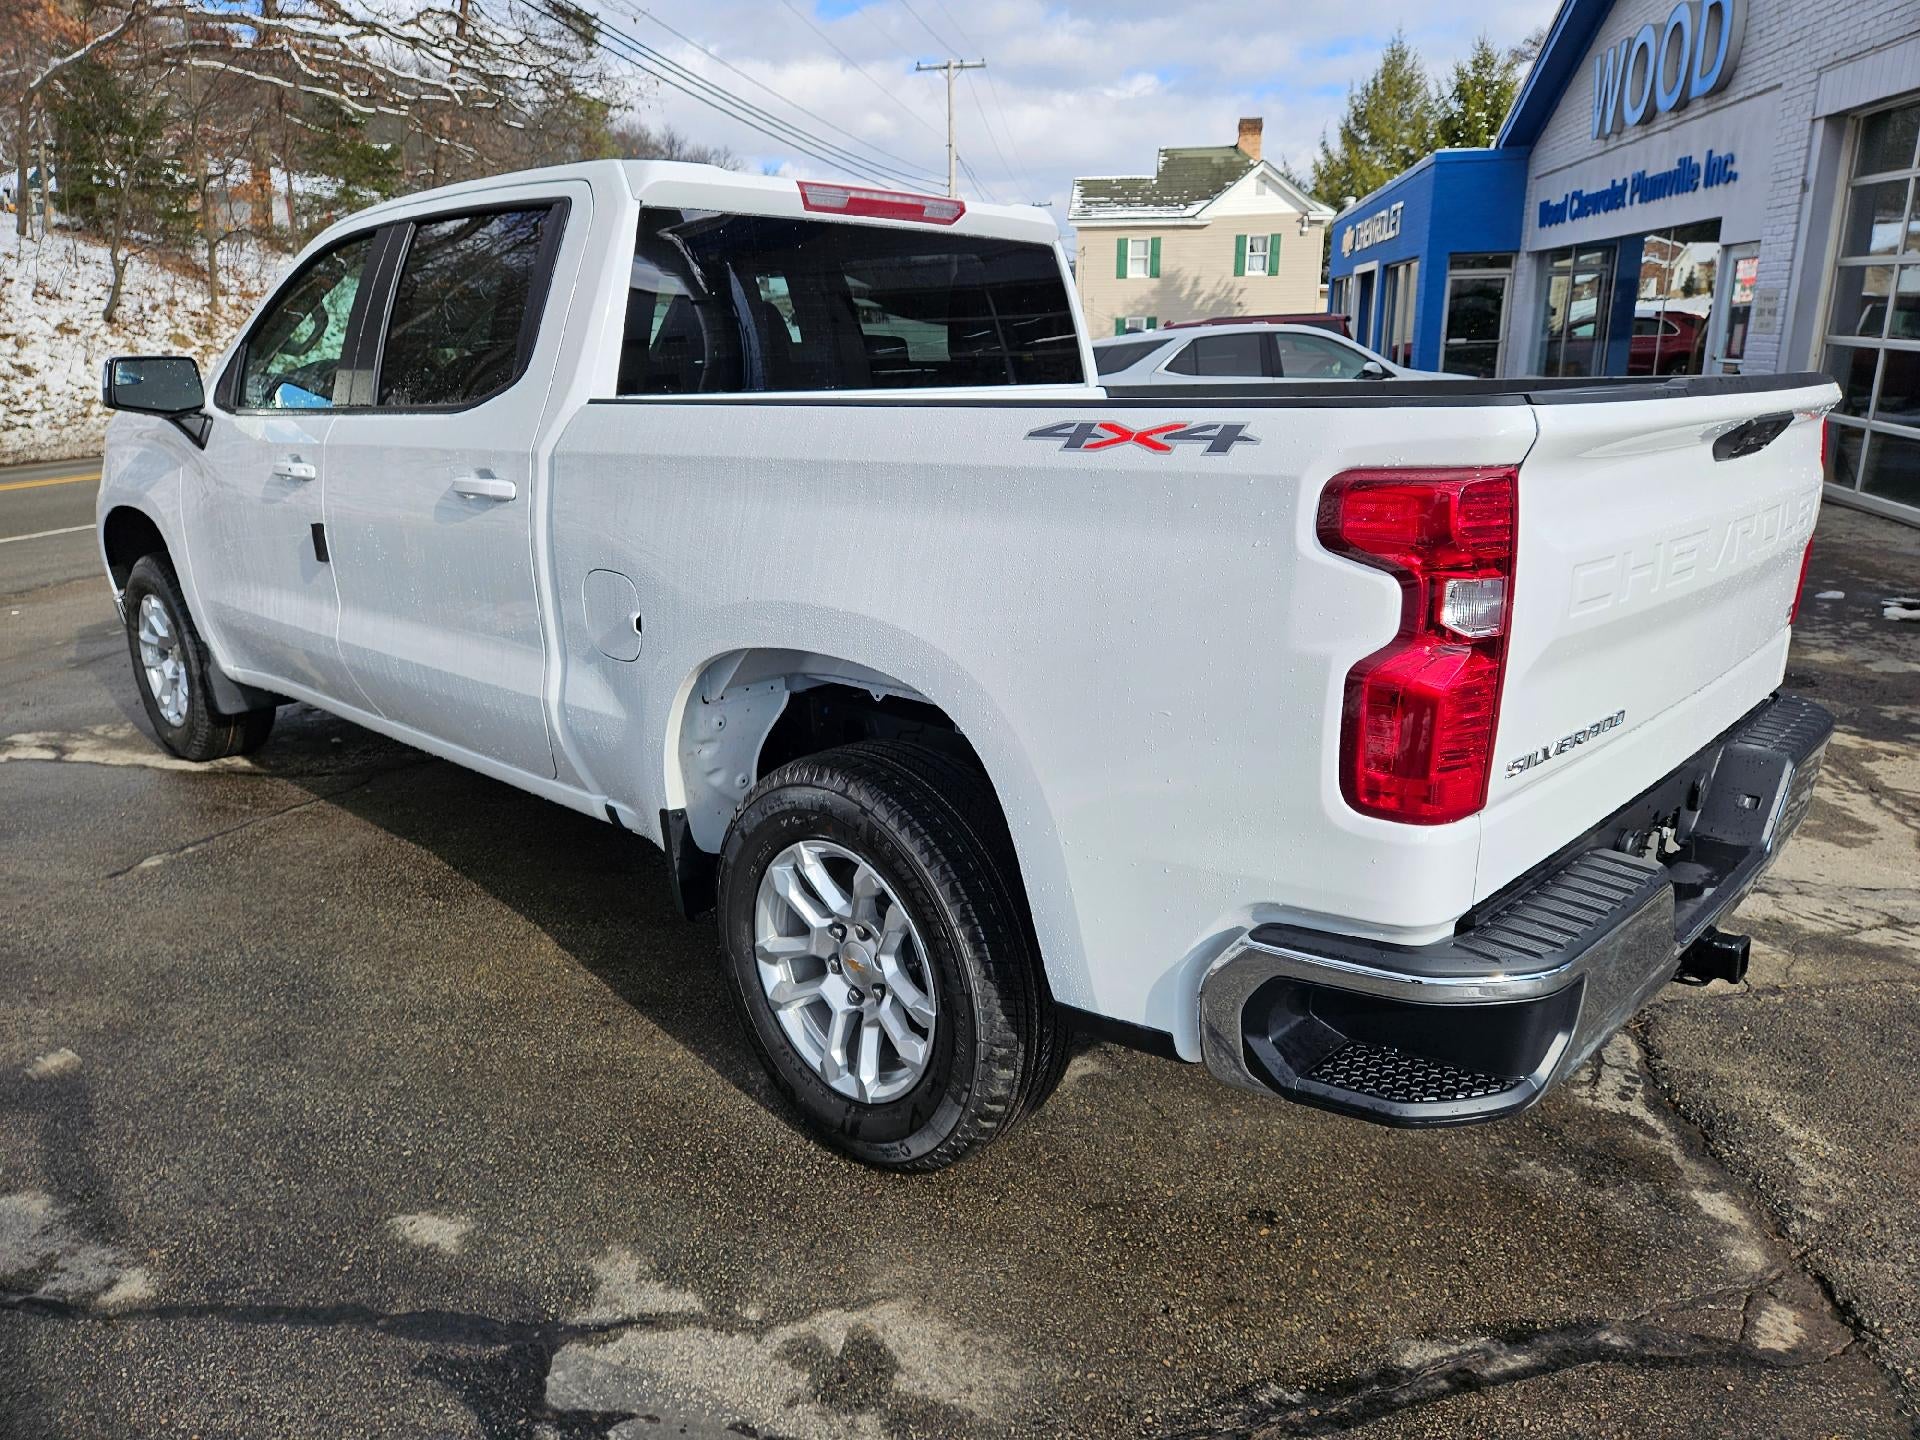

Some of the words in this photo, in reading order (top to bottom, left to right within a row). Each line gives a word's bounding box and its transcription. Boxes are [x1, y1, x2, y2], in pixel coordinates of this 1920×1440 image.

[1592, 0, 1738, 140] WOOD
[1355, 200, 1404, 252] CHEVROLET
[1538, 194, 1569, 228] Wood
[1568, 177, 1629, 221] Chevrolet
[1628, 155, 1700, 206] Plumville
[1703, 149, 1738, 189] Inc.
[1568, 486, 1820, 618] CHEVROLET
[1505, 709, 1626, 779] SILVERADO
